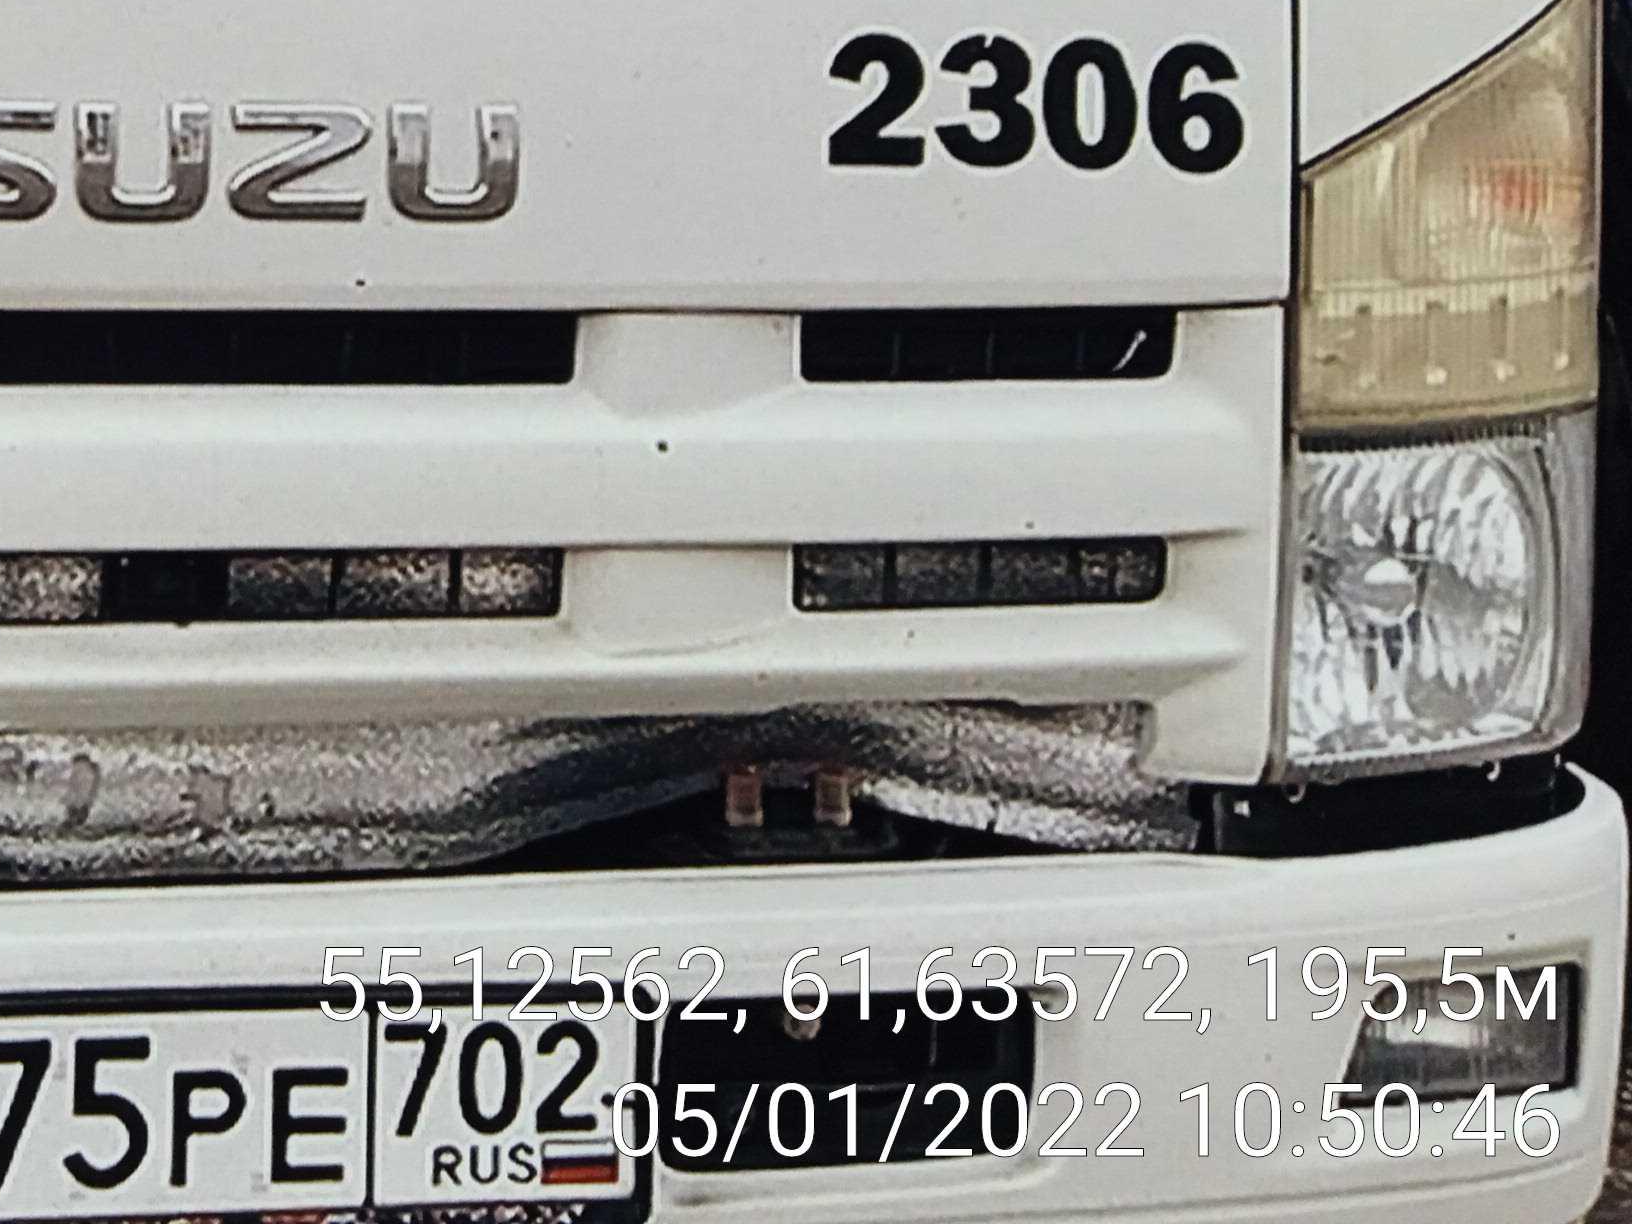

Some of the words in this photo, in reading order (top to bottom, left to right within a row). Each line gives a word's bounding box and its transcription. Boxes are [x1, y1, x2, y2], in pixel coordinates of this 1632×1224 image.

[828, 32, 1245, 172] 2306
[382, 1019, 599, 1137] 702
[431, 1142, 538, 1185] RUS
